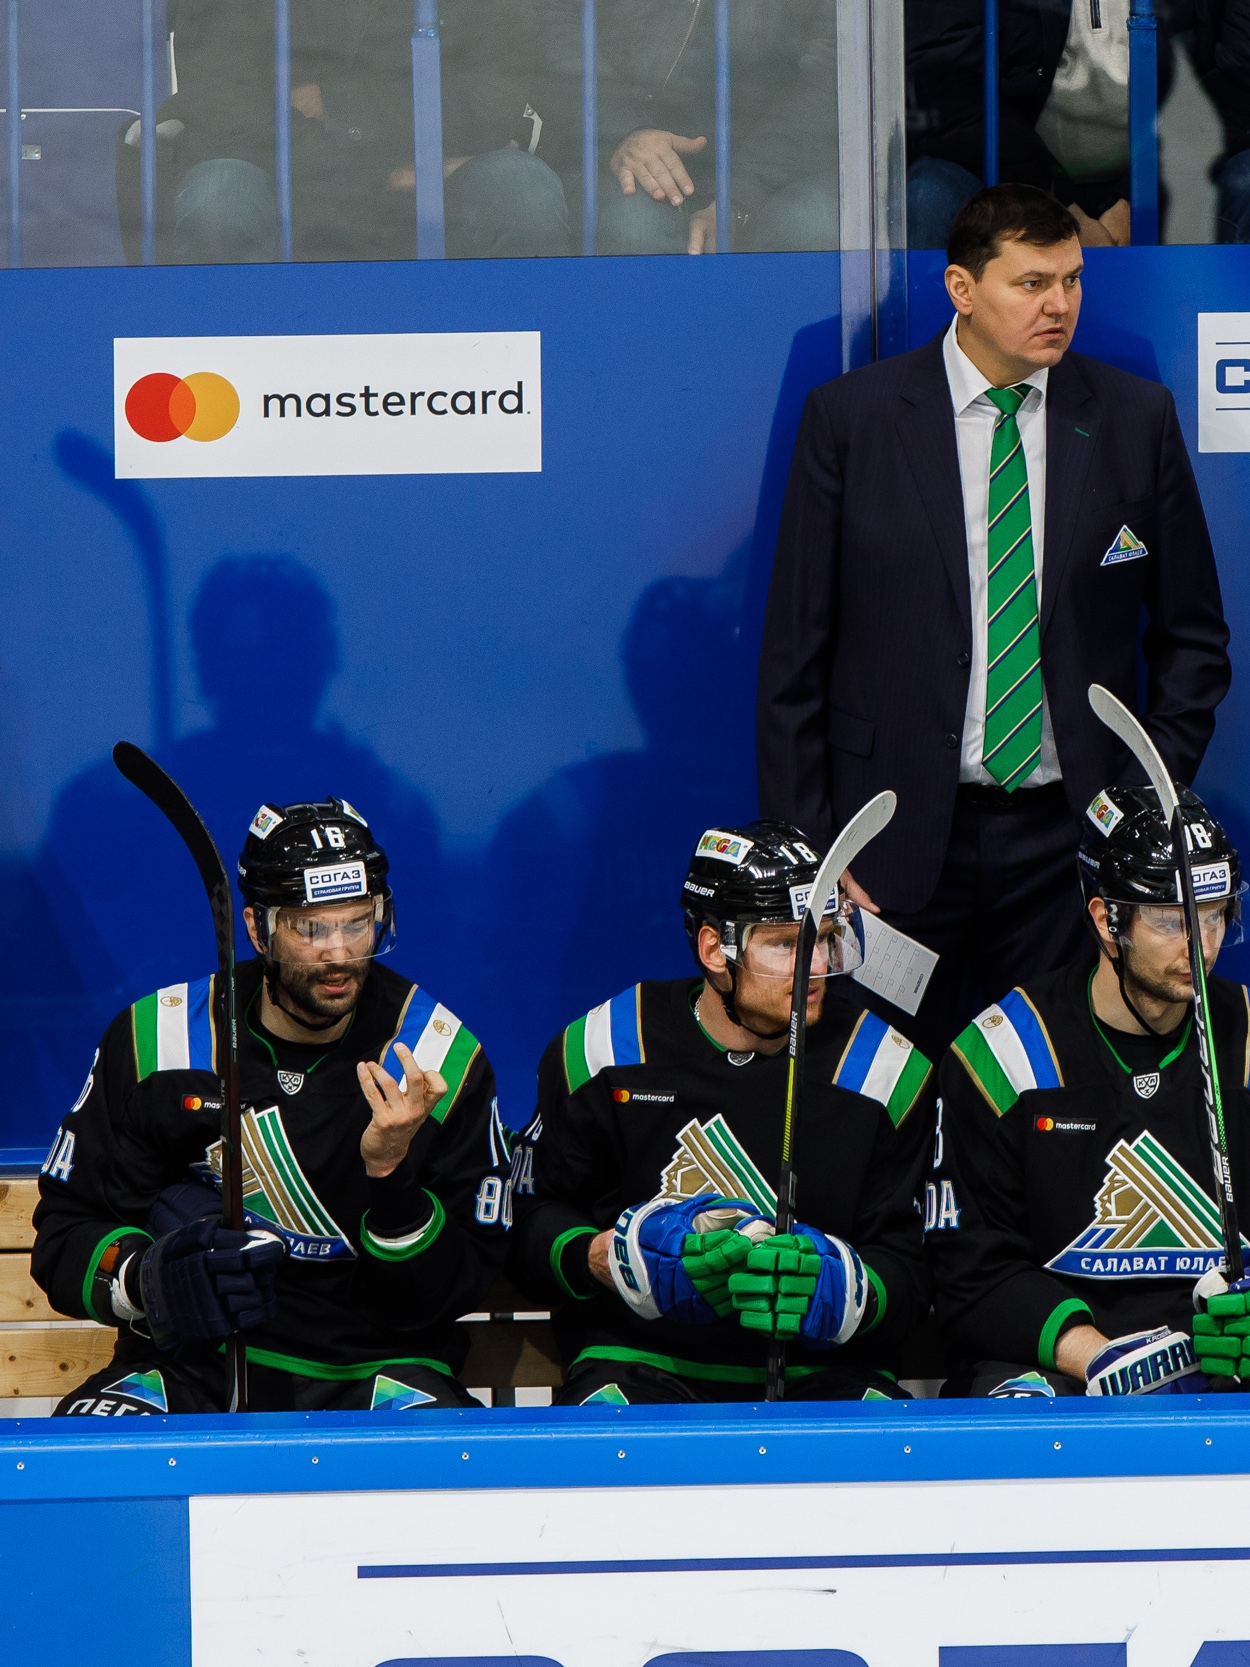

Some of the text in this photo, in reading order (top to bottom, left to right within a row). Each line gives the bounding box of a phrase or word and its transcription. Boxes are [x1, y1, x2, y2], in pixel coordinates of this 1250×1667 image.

[310, 825, 346, 850] 16
[780, 842, 818, 865] 18
[309, 869, 361, 886] СОГАЗ
[1193, 869, 1227, 885] ОГАЗ
[683, 880, 716, 898] BAUER
[789, 1010, 799, 1057] BAUER
[632, 1093, 675, 1103] mastercard
[1055, 1121, 1096, 1131] mastercard
[1221, 1156, 1234, 1203] BAUER
[1081, 1256, 1228, 1273] САЛАВАТ ЮЛАЕ
[66, 1398, 151, 1417] ПЕГ
